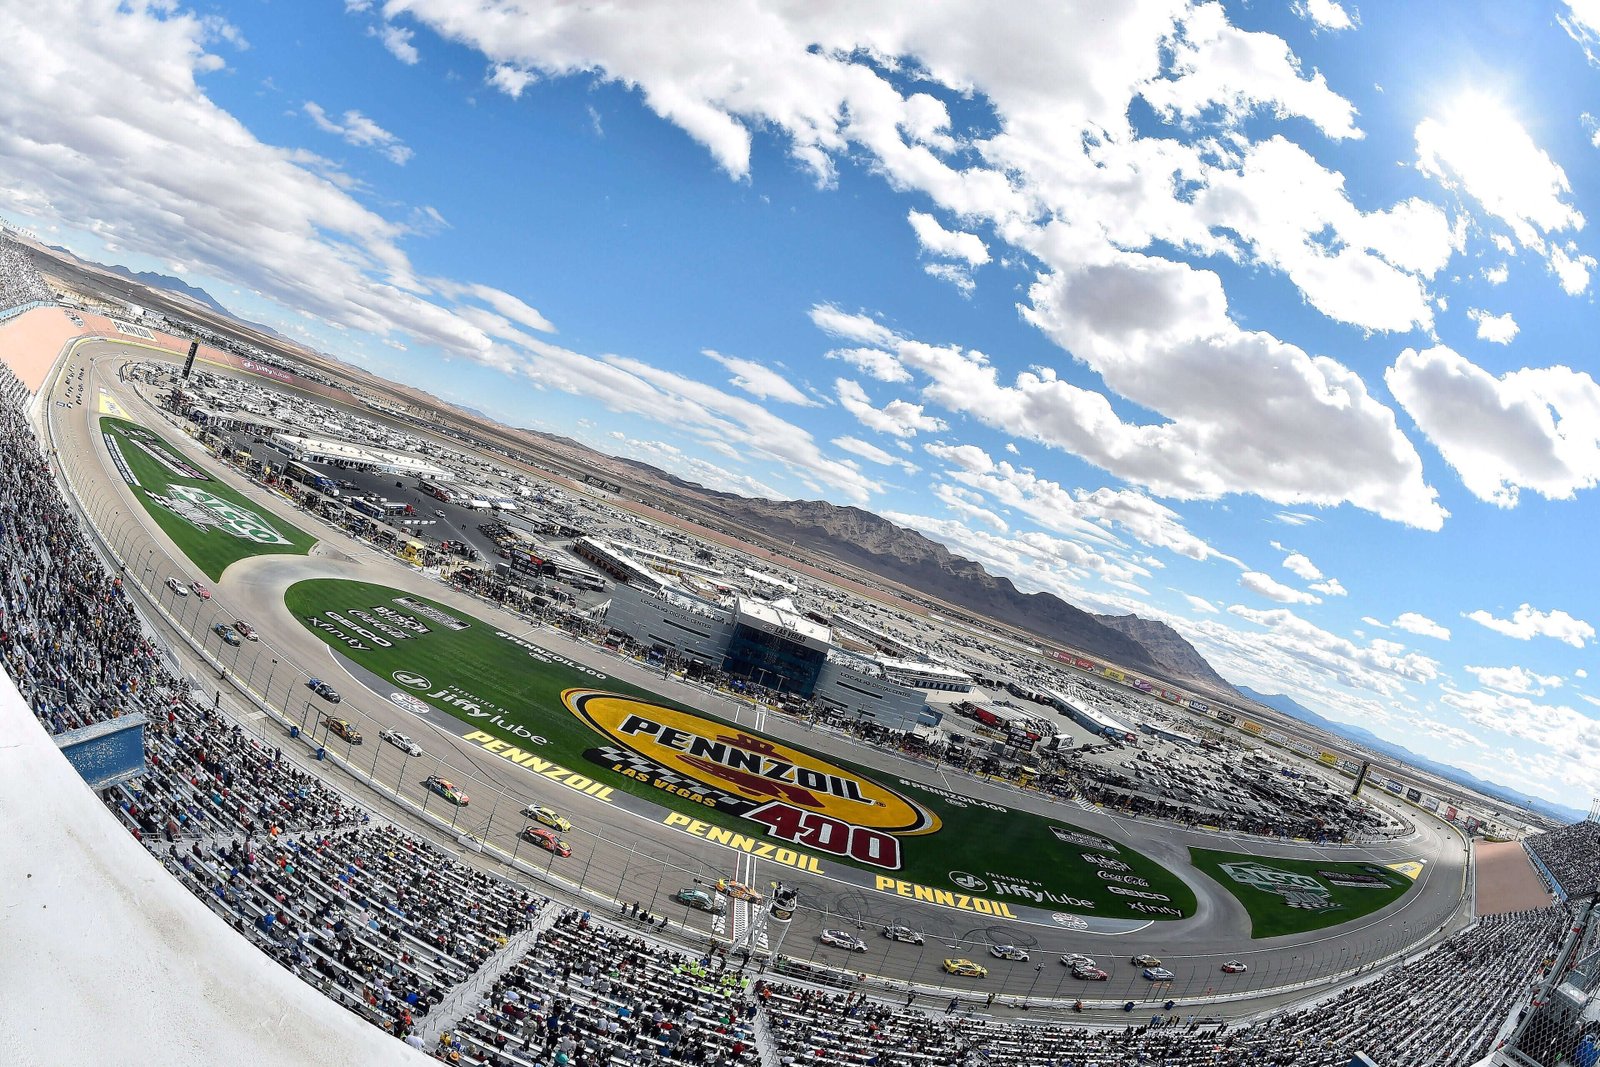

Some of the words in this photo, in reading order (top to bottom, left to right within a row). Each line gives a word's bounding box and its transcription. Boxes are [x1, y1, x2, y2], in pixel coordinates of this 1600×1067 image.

[114, 321, 154, 340] PENNZOIL
[307, 616, 371, 650] xfinity
[325, 611, 392, 647] GEICO
[669, 610, 690, 622] DIGITAL
[690, 618, 712, 630] CENTER
[495, 631, 607, 680] #PENNZOIL400
[449, 684, 495, 709] PRESENTED
[498, 707, 510, 715] BY
[426, 688, 491, 718] jiffy
[489, 714, 549, 747] lube
[462, 730, 616, 802] PENNZOIL
[617, 713, 877, 805] PENNZOIL
[611, 763, 651, 783] LAS
[653, 778, 718, 808] VEGAS
[900, 779, 1008, 814] #PENNZOIL400
[663, 811, 825, 875] PENNZOIL
[741, 801, 901, 871] 400
[875, 874, 1018, 919] PENNZOIL
[986, 872, 1031, 886] PRESENTED
[992, 880, 1044, 903] jiffy
[1044, 890, 1096, 909] lube
[1107, 885, 1171, 902] GEICO
[1127, 901, 1182, 918] xfinity
